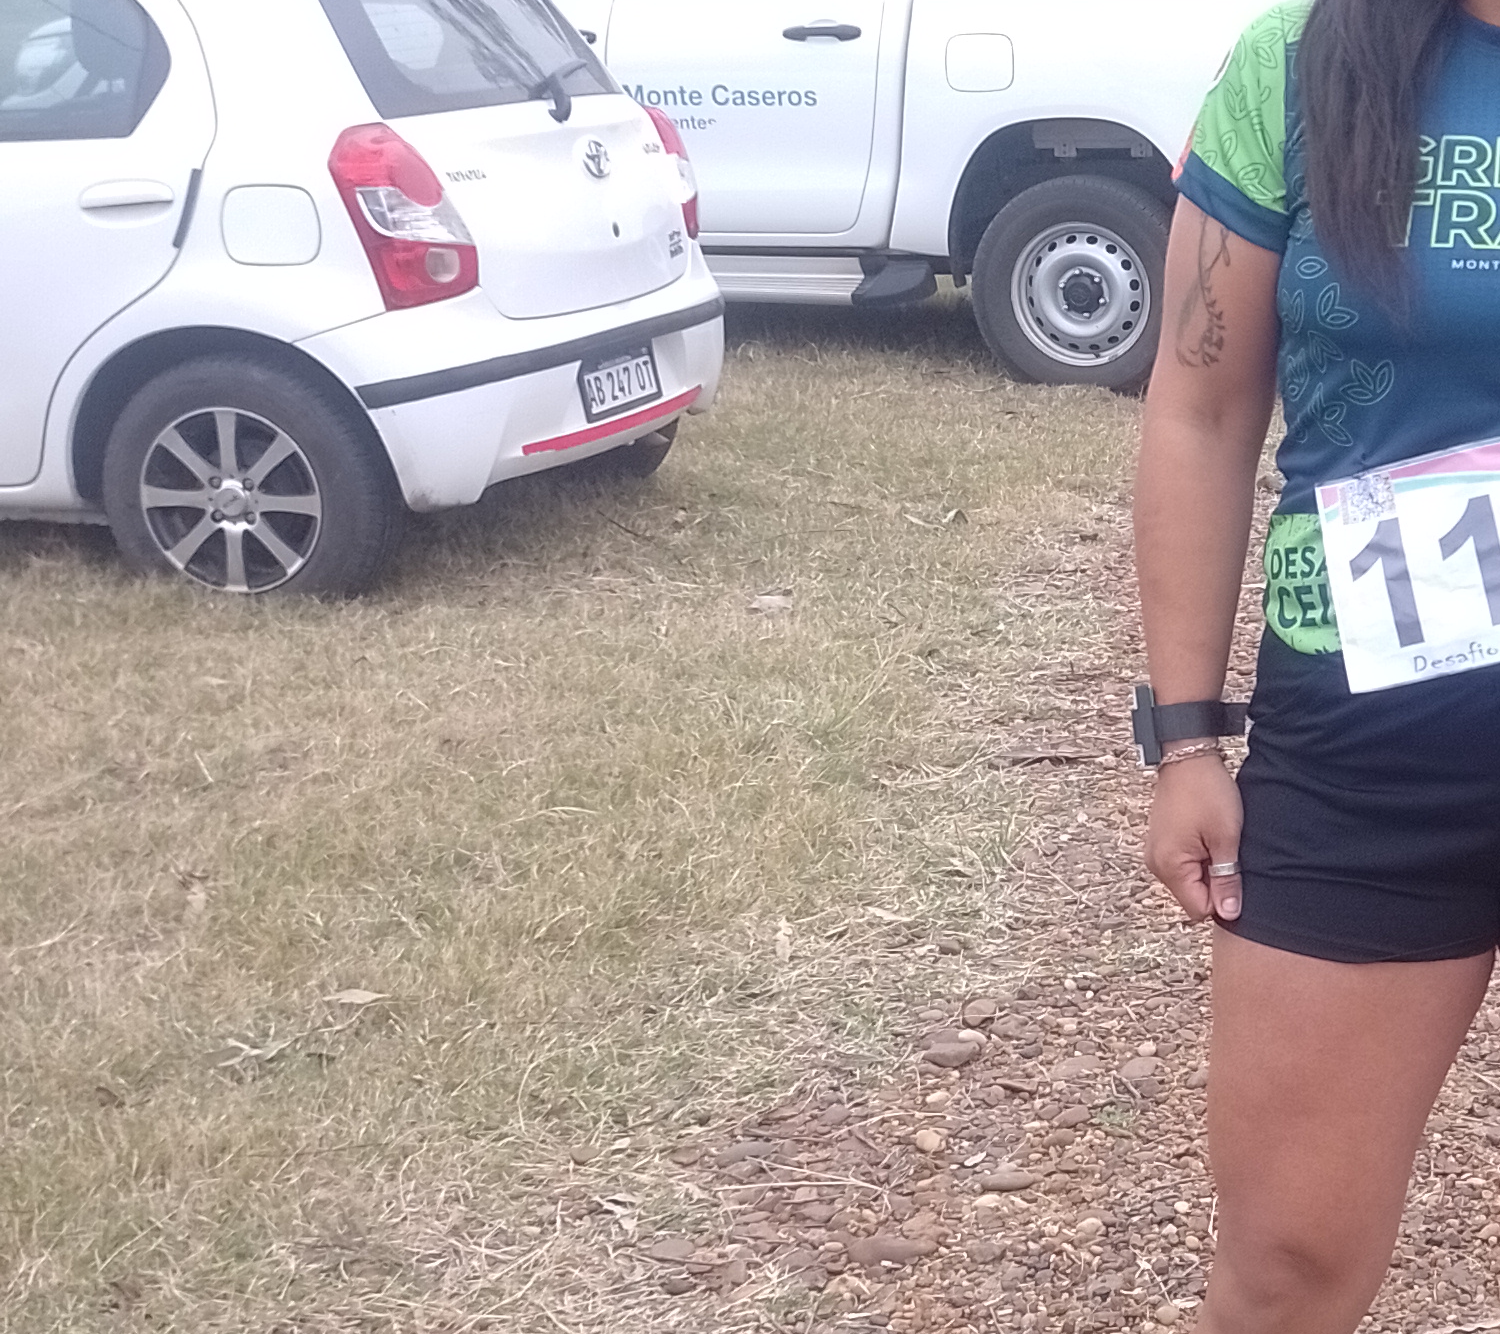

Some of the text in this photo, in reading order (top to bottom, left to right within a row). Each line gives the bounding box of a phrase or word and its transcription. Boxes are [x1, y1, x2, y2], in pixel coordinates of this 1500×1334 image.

[621, 84, 818, 107] Monte Caseros
[586, 375, 606, 407] AB
[606, 366, 632, 401] 247
